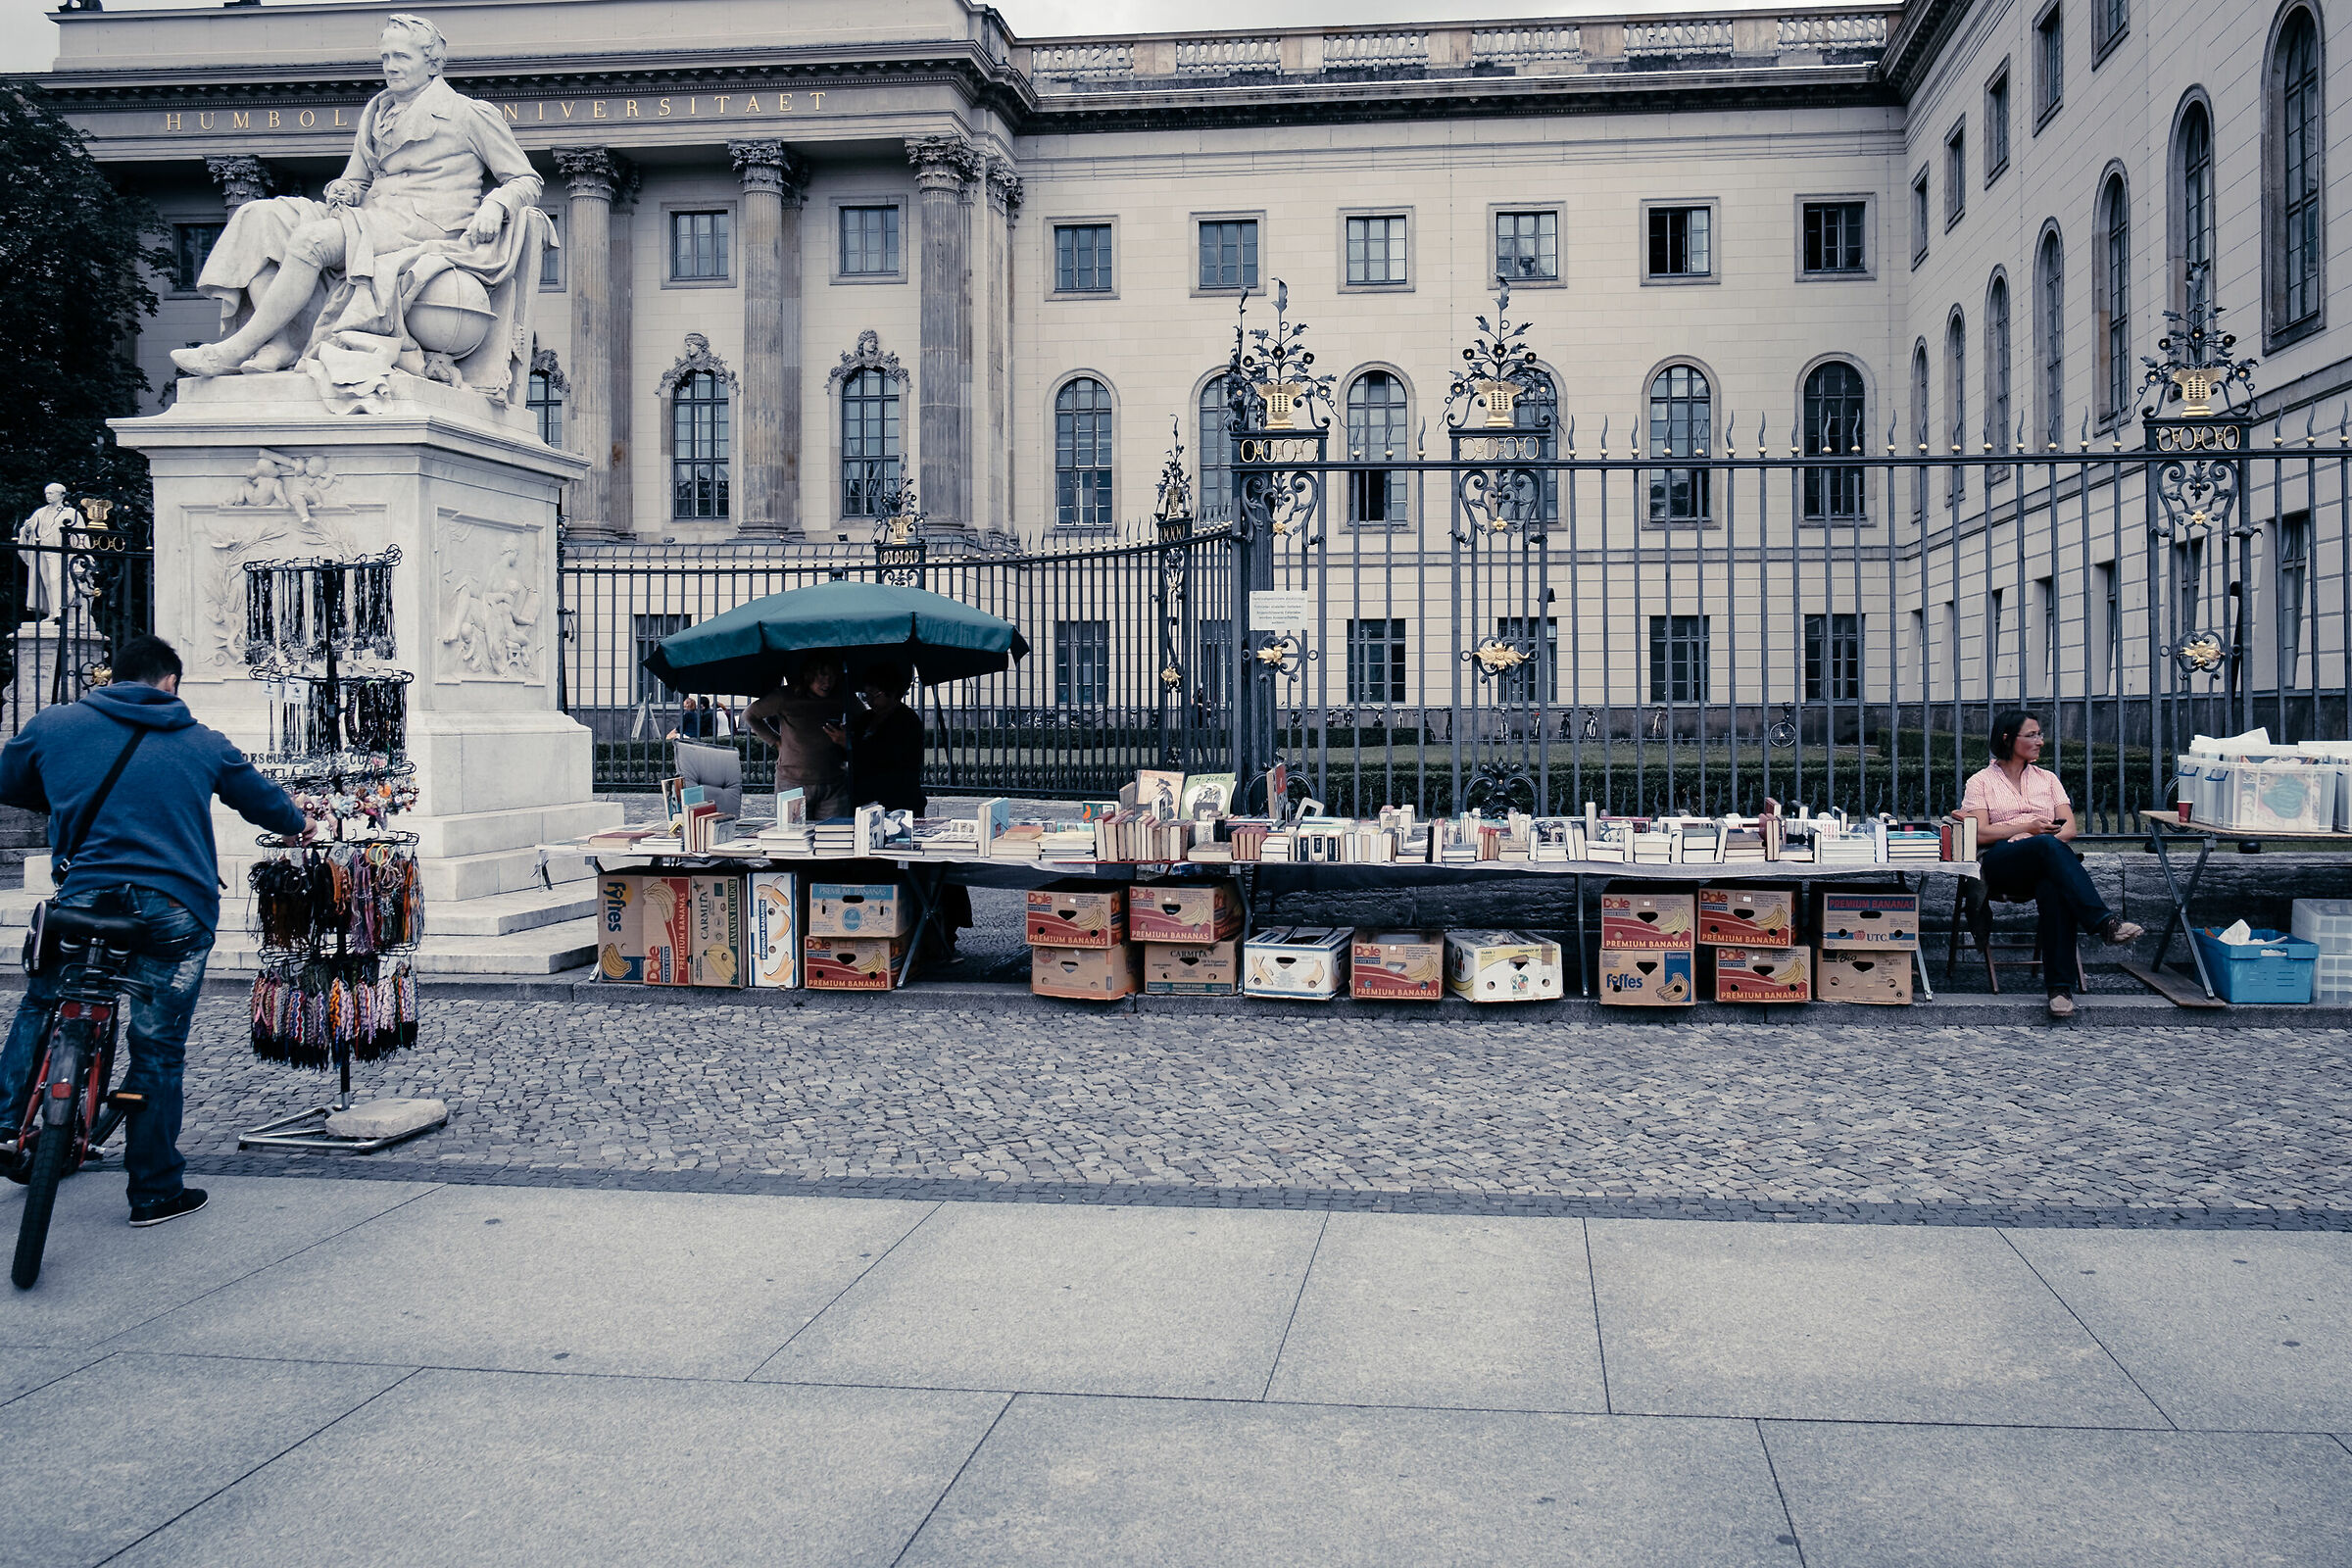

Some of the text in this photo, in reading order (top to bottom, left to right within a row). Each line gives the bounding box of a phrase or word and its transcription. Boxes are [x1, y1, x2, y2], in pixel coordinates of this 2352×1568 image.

[166, 92, 827, 131] HUMBOL NIVERSITAET
[728, 878, 738, 912] ECUADOR
[854, 887, 886, 896] BANANAS
[1131, 888, 1154, 900] Dole
[1700, 891, 1728, 903] Dole
[1028, 893, 1052, 905] Dole
[1603, 898, 1631, 909] Dole
[1829, 900, 1914, 908] PREMIUM BANANAS
[699, 891, 709, 940] CARMITA
[1029, 934, 1065, 943] PREMIUM
[1131, 930, 1208, 941] PREMIUM BANANAS
[1701, 934, 1787, 946] PREMIUM BANANAS
[807, 939, 831, 951] Dole
[1354, 944, 1381, 956] Dole
[1718, 949, 1746, 960] Dole
[1838, 953, 1857, 962] Bio
[646, 945, 661, 982] Dole
